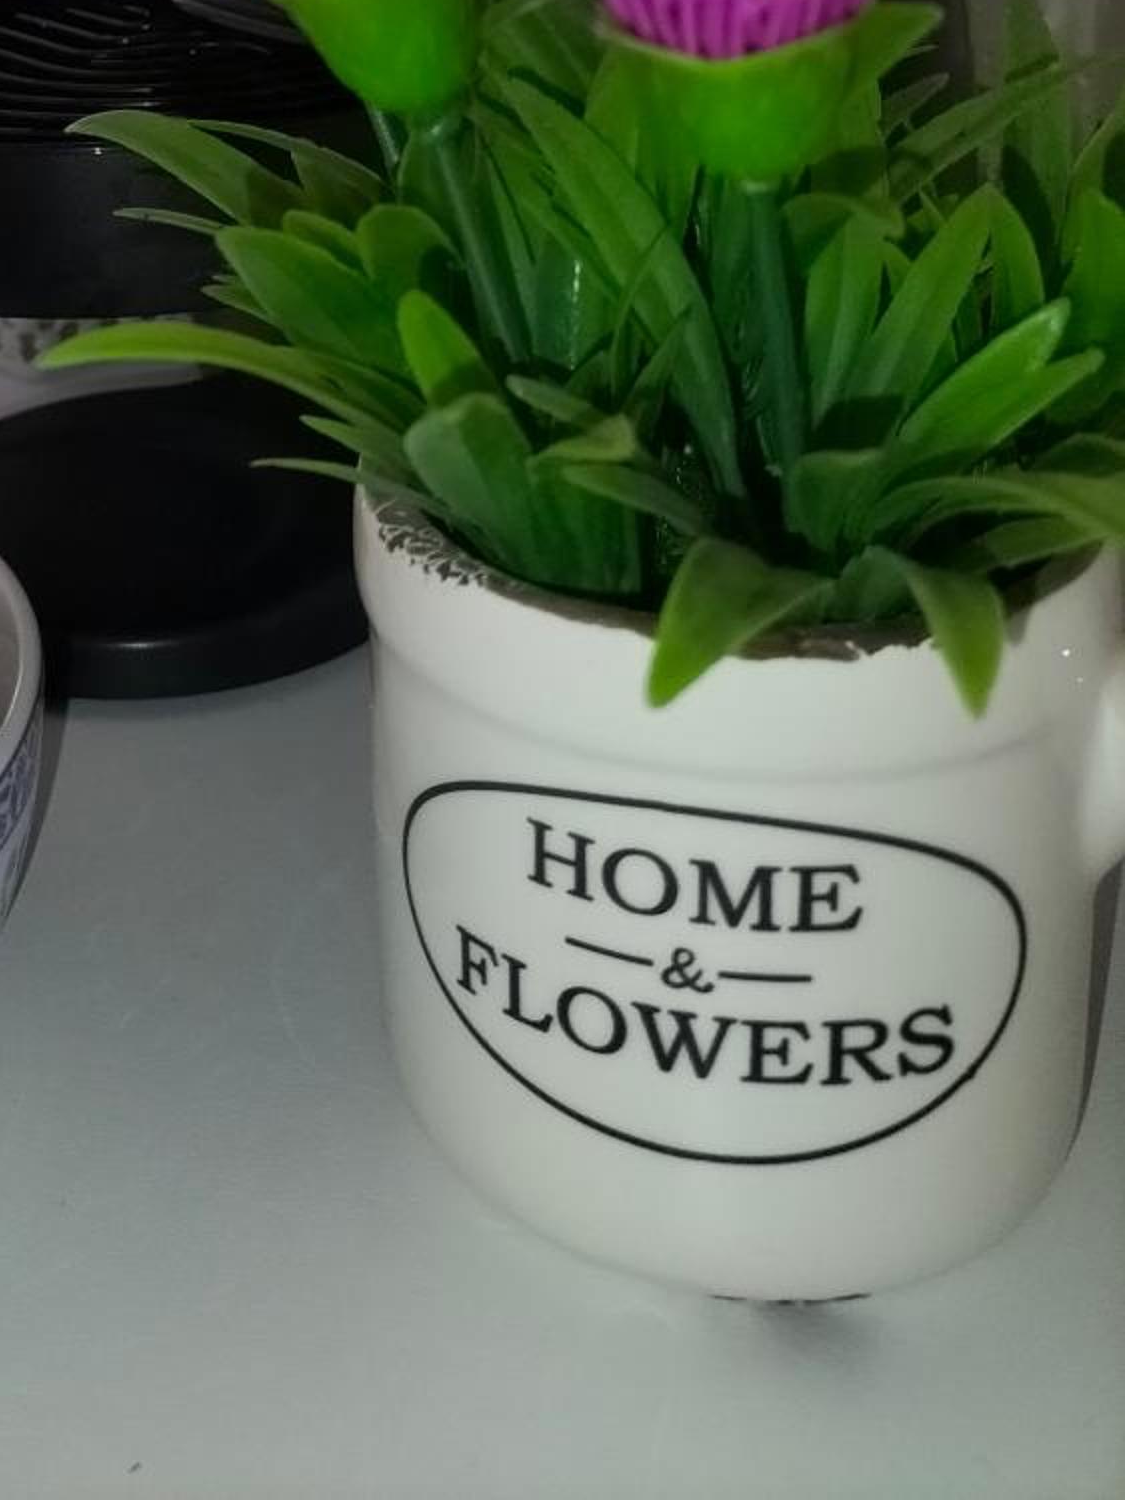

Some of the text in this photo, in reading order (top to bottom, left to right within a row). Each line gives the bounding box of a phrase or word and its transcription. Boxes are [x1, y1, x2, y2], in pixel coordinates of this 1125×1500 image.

[526, 816, 864, 933] HOME
[456, 924, 955, 1086] FLOWERS
[661, 947, 715, 994] &
